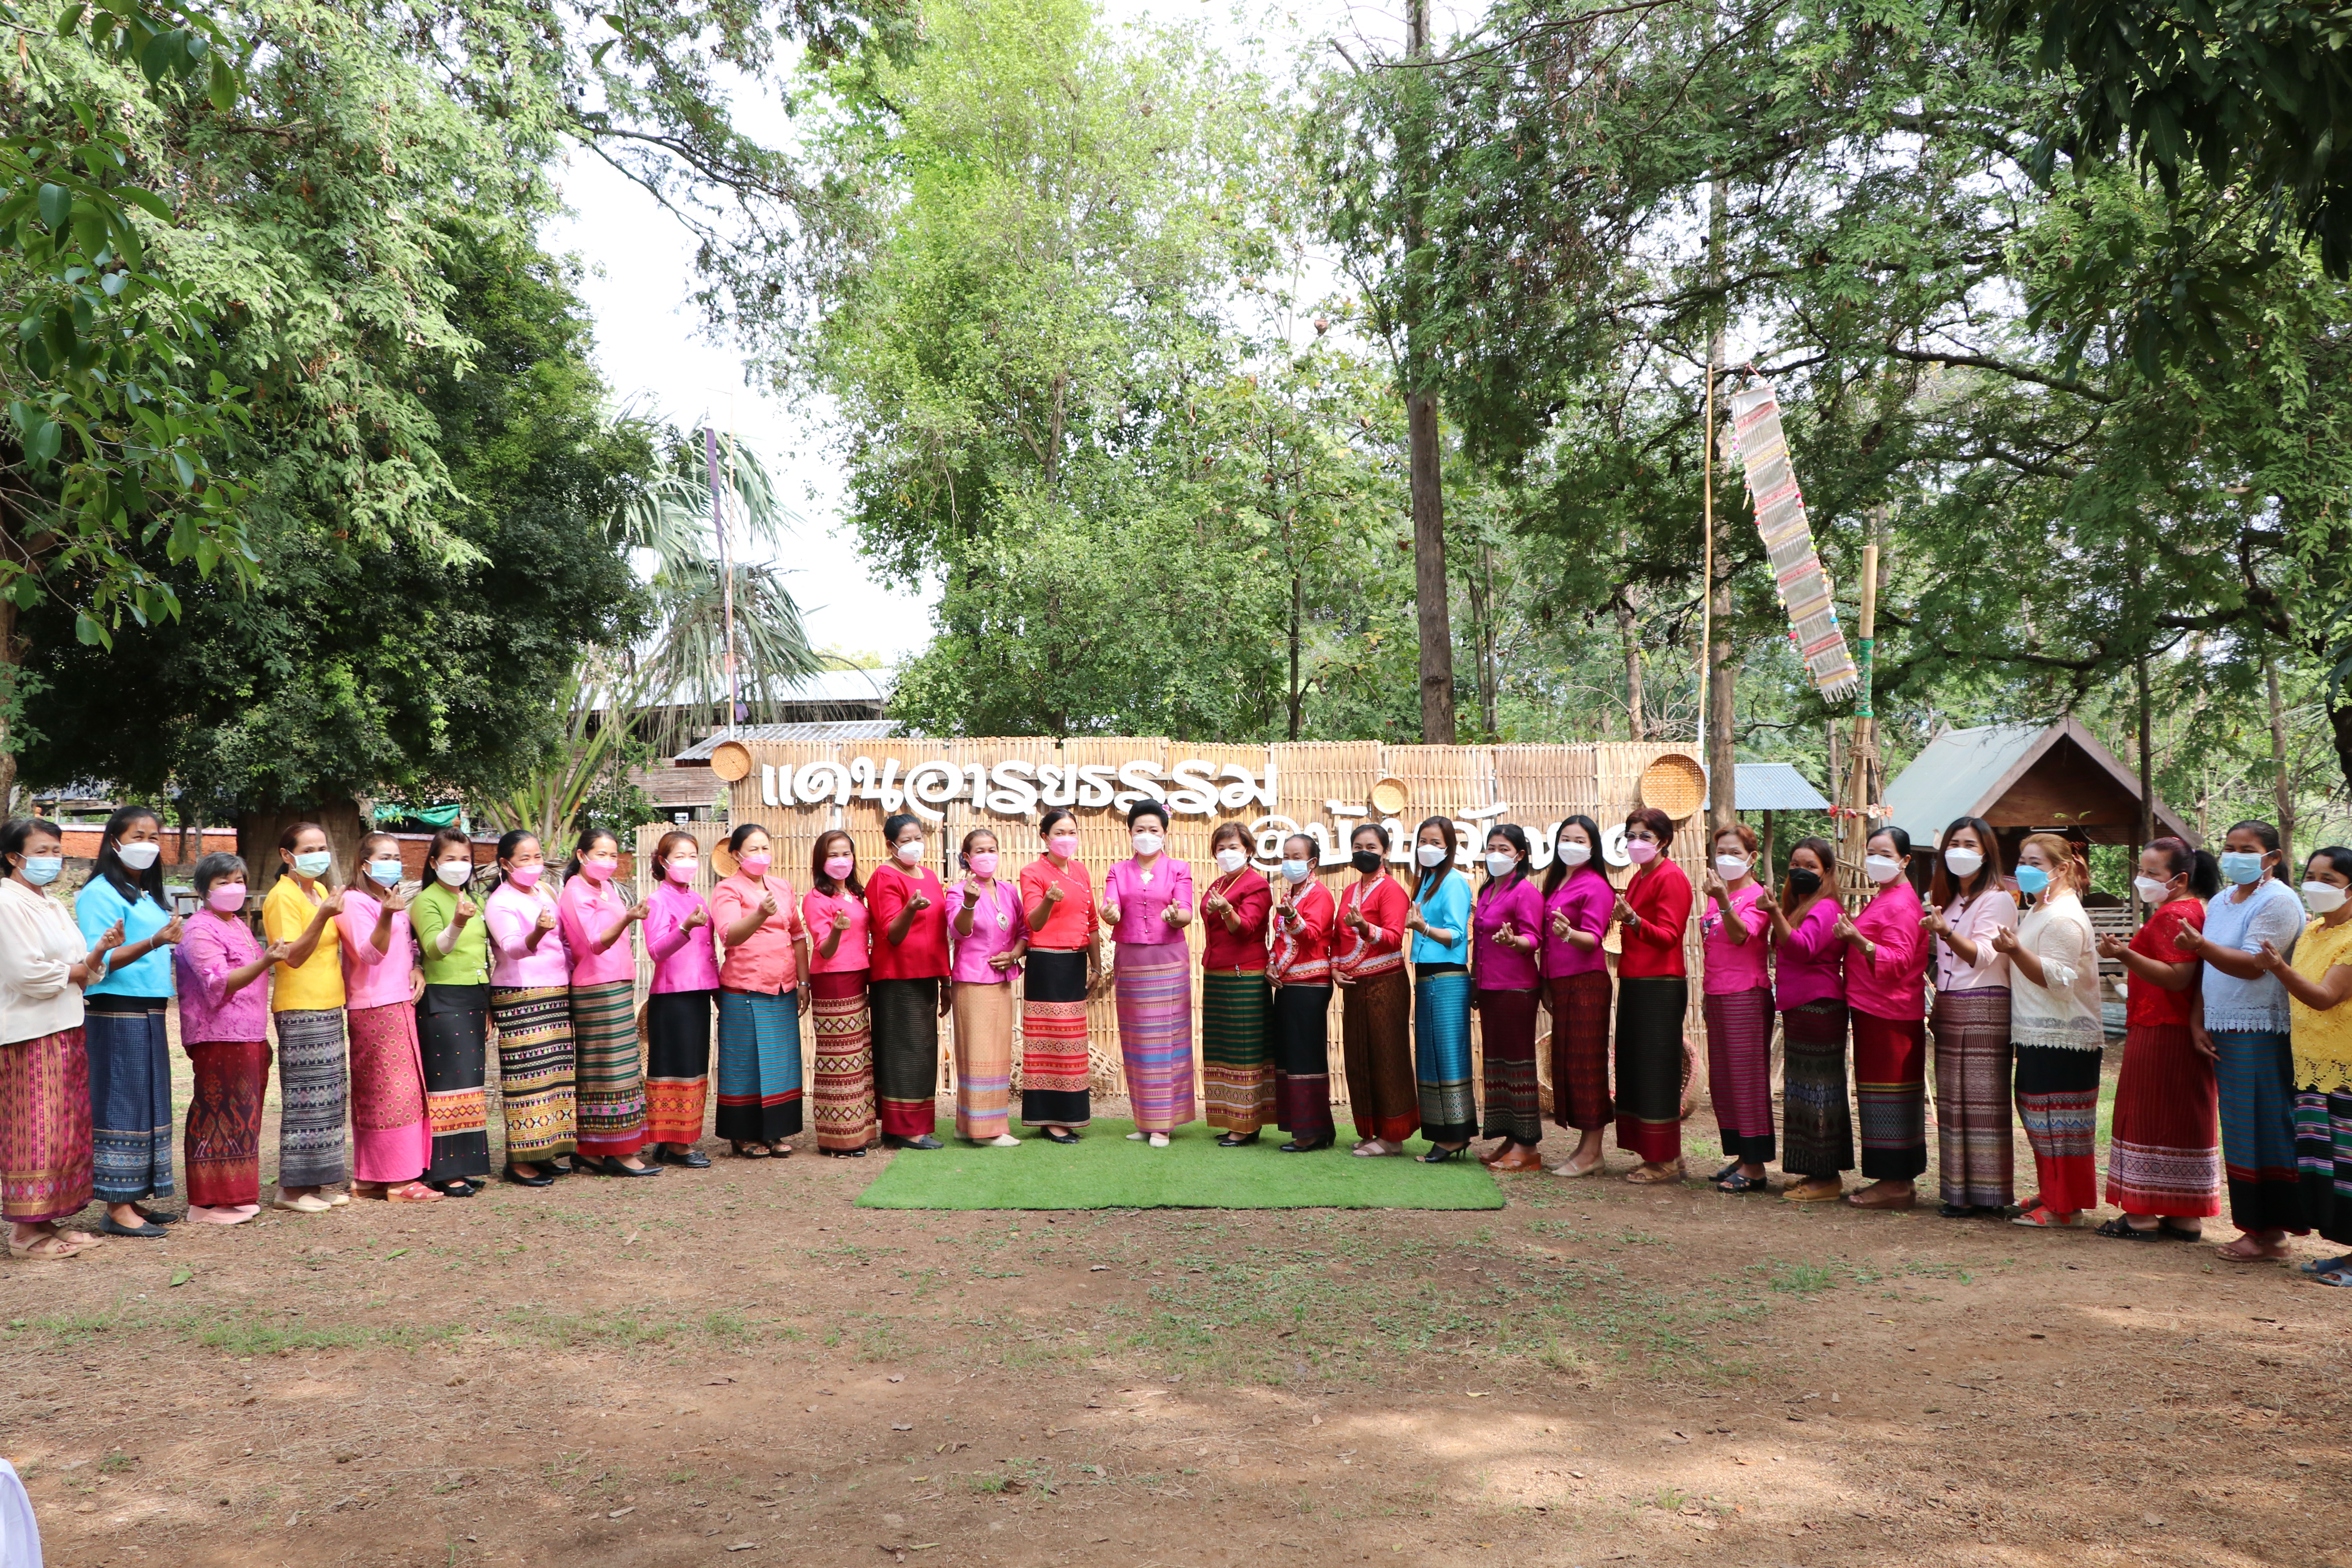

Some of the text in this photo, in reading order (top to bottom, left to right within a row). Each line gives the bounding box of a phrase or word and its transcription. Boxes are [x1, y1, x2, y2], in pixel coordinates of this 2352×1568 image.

[762, 756, 1277, 821] แดนอารยธรรม
